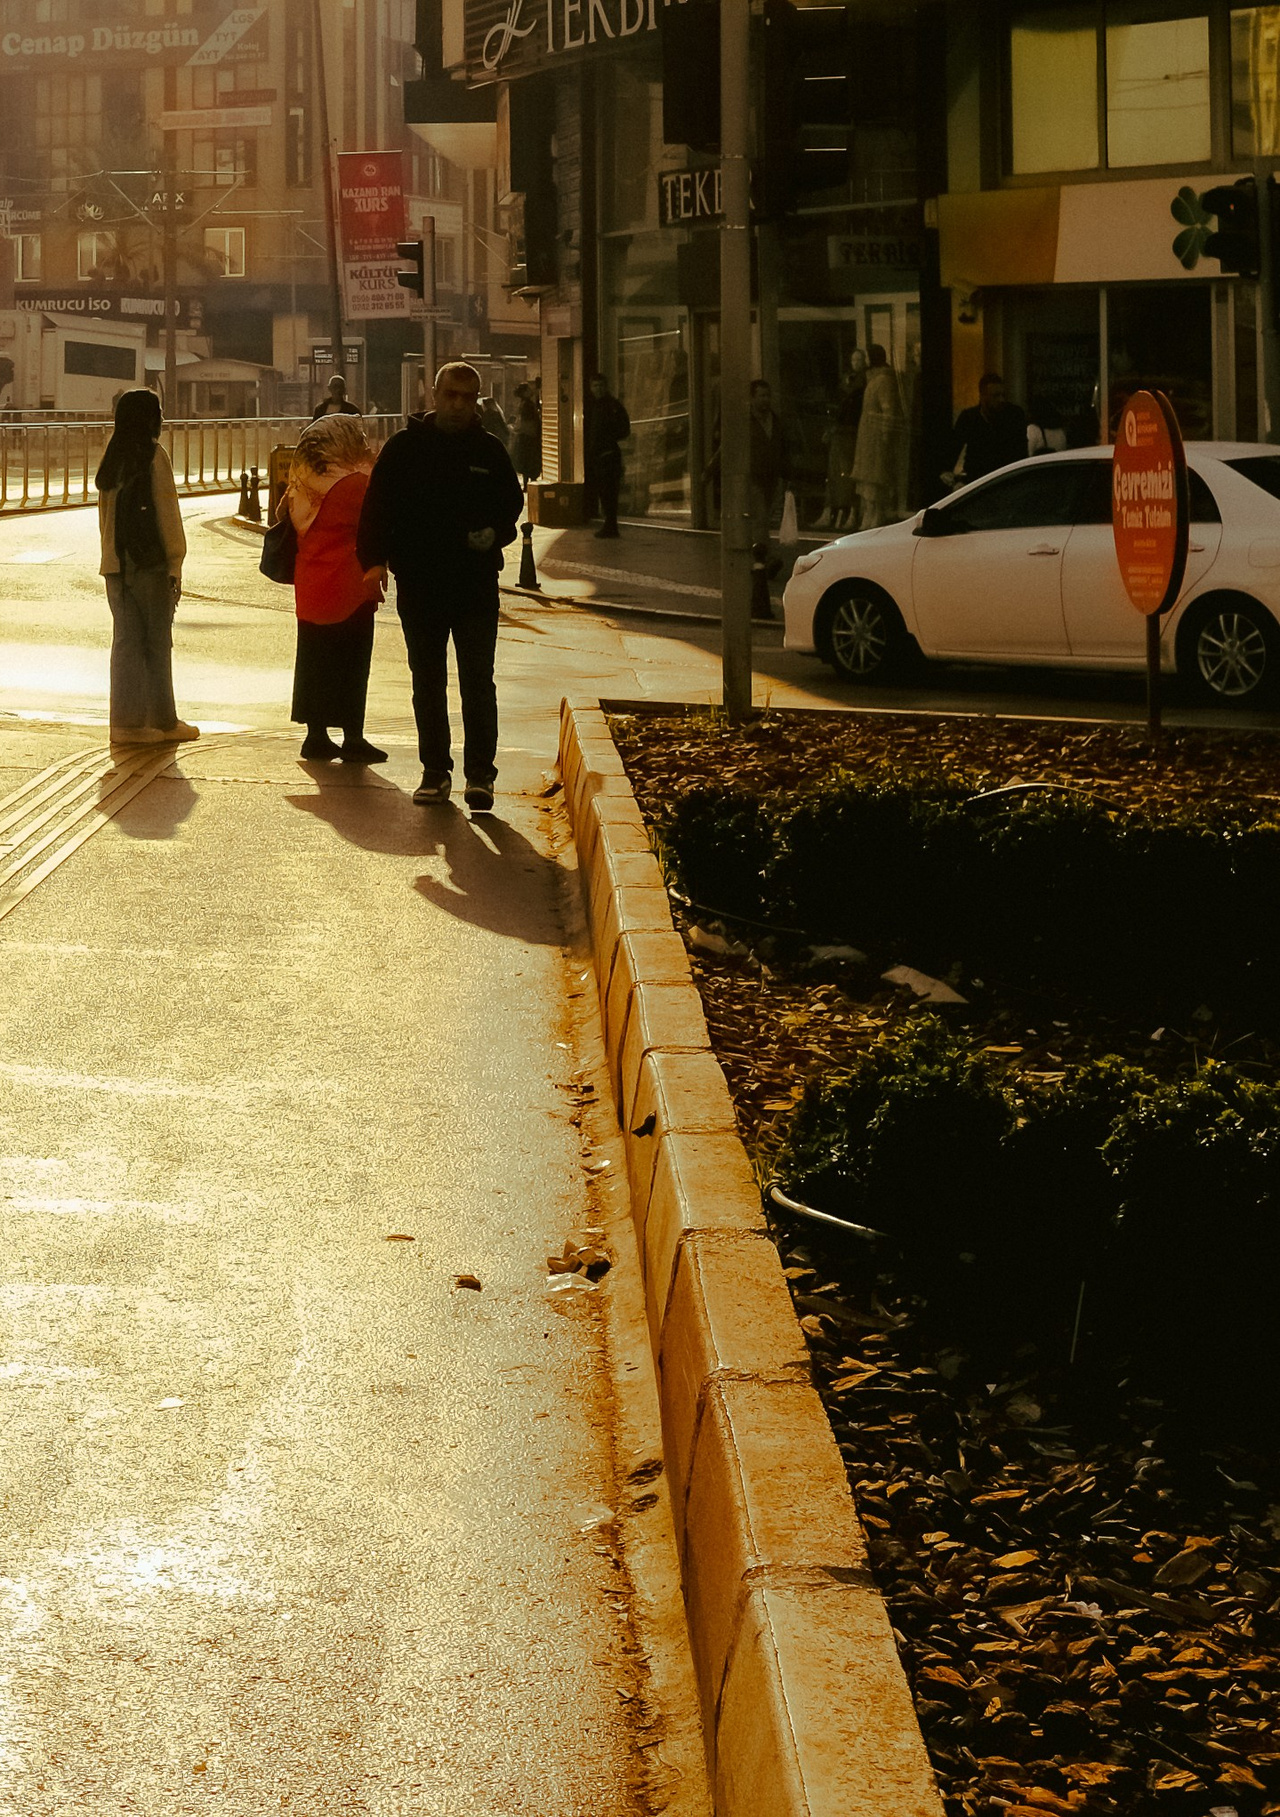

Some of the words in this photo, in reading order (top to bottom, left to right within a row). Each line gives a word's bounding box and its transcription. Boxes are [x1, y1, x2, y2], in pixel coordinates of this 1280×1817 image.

[231, 13, 254, 24] LGS
[1, 32, 86, 58] Cenap
[92, 22, 200, 55] Düzgün
[215, 31, 237, 42] TYT
[198, 50, 220, 60] AYT
[359, 278, 396, 291] KURS
[17, 299, 85, 311] KUMRUCU
[88, 296, 111, 311] İSO
[1113, 460, 1173, 512] Çevremizi
[1121, 504, 1143, 529] Temiz
